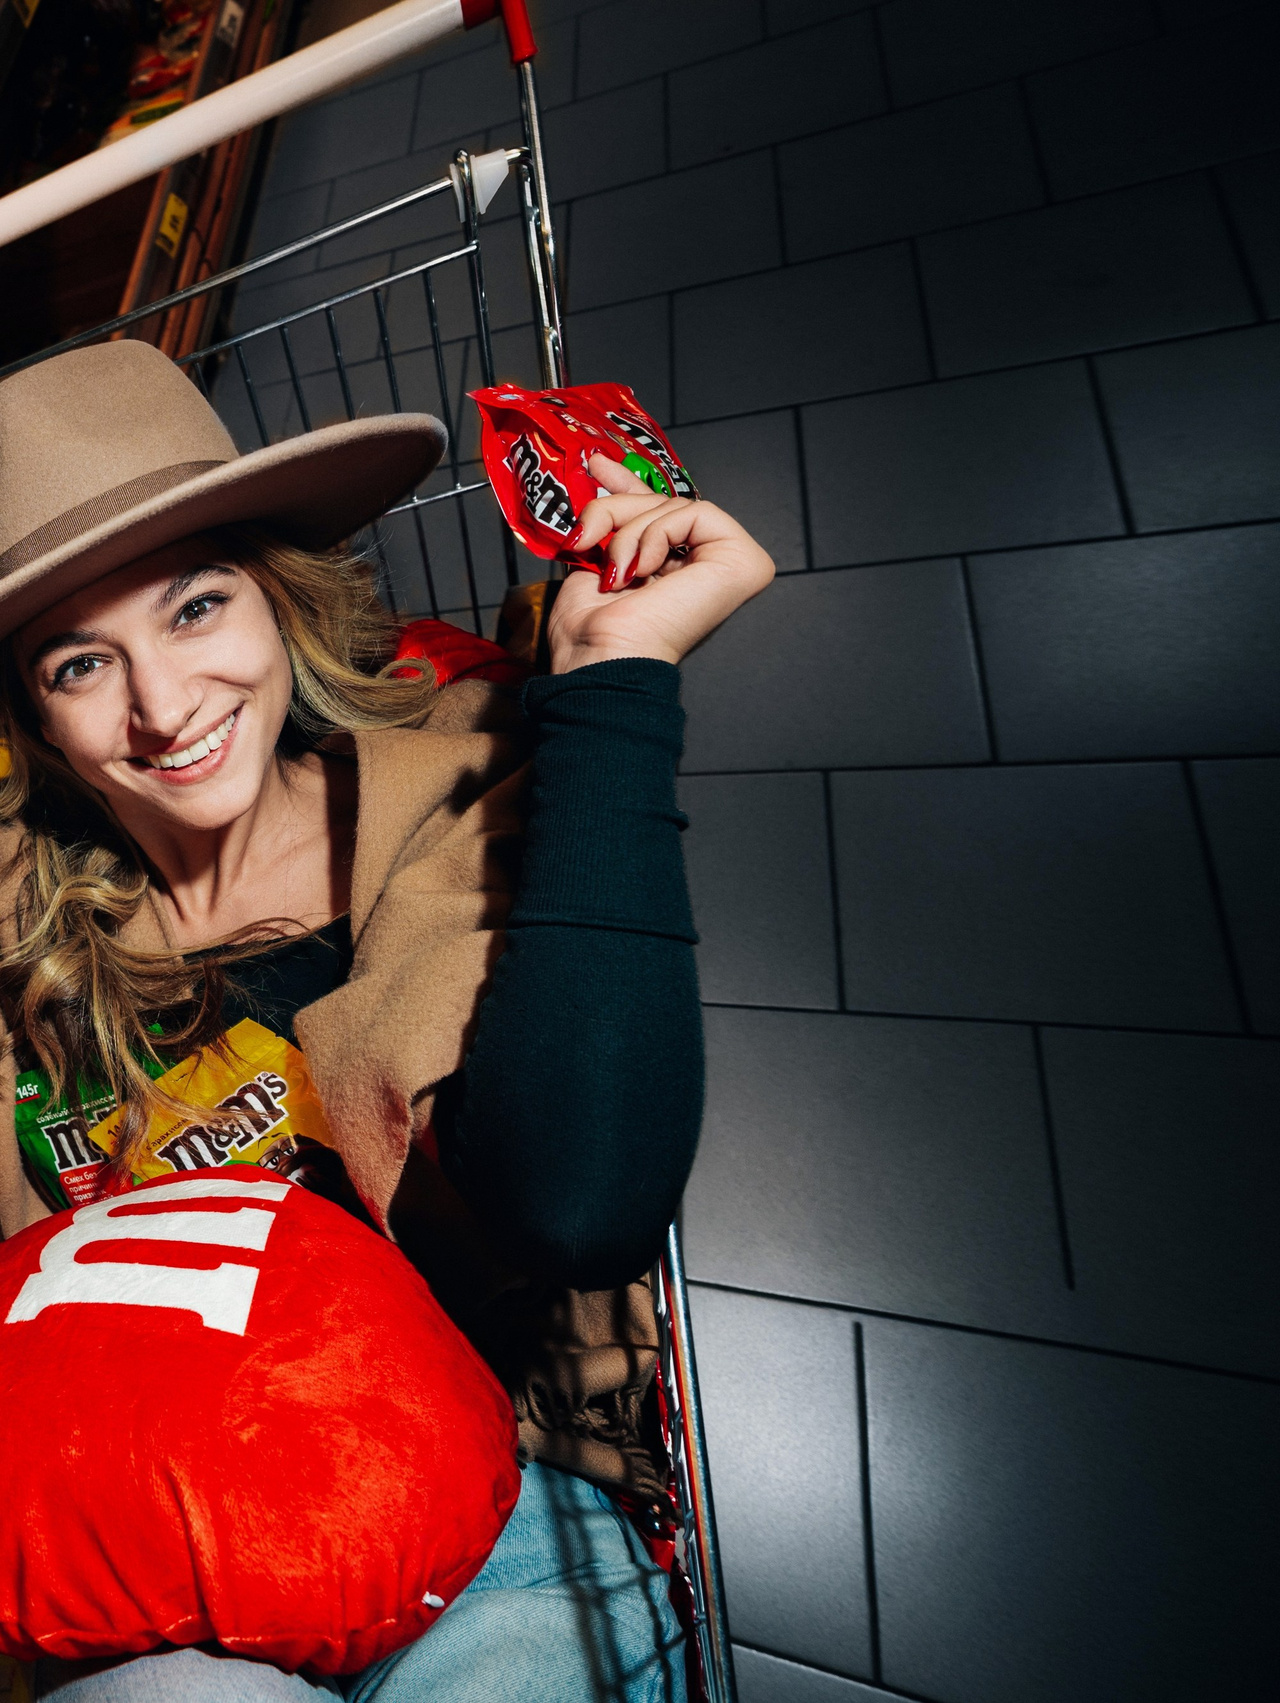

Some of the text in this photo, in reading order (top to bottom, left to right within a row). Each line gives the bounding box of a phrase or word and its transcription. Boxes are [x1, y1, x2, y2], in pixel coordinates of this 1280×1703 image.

[502, 431, 578, 537] m&m
[16, 1084, 38, 1099] 145г
[155, 1071, 289, 1171] m&m's
[63, 1171, 97, 1186] Смех без
